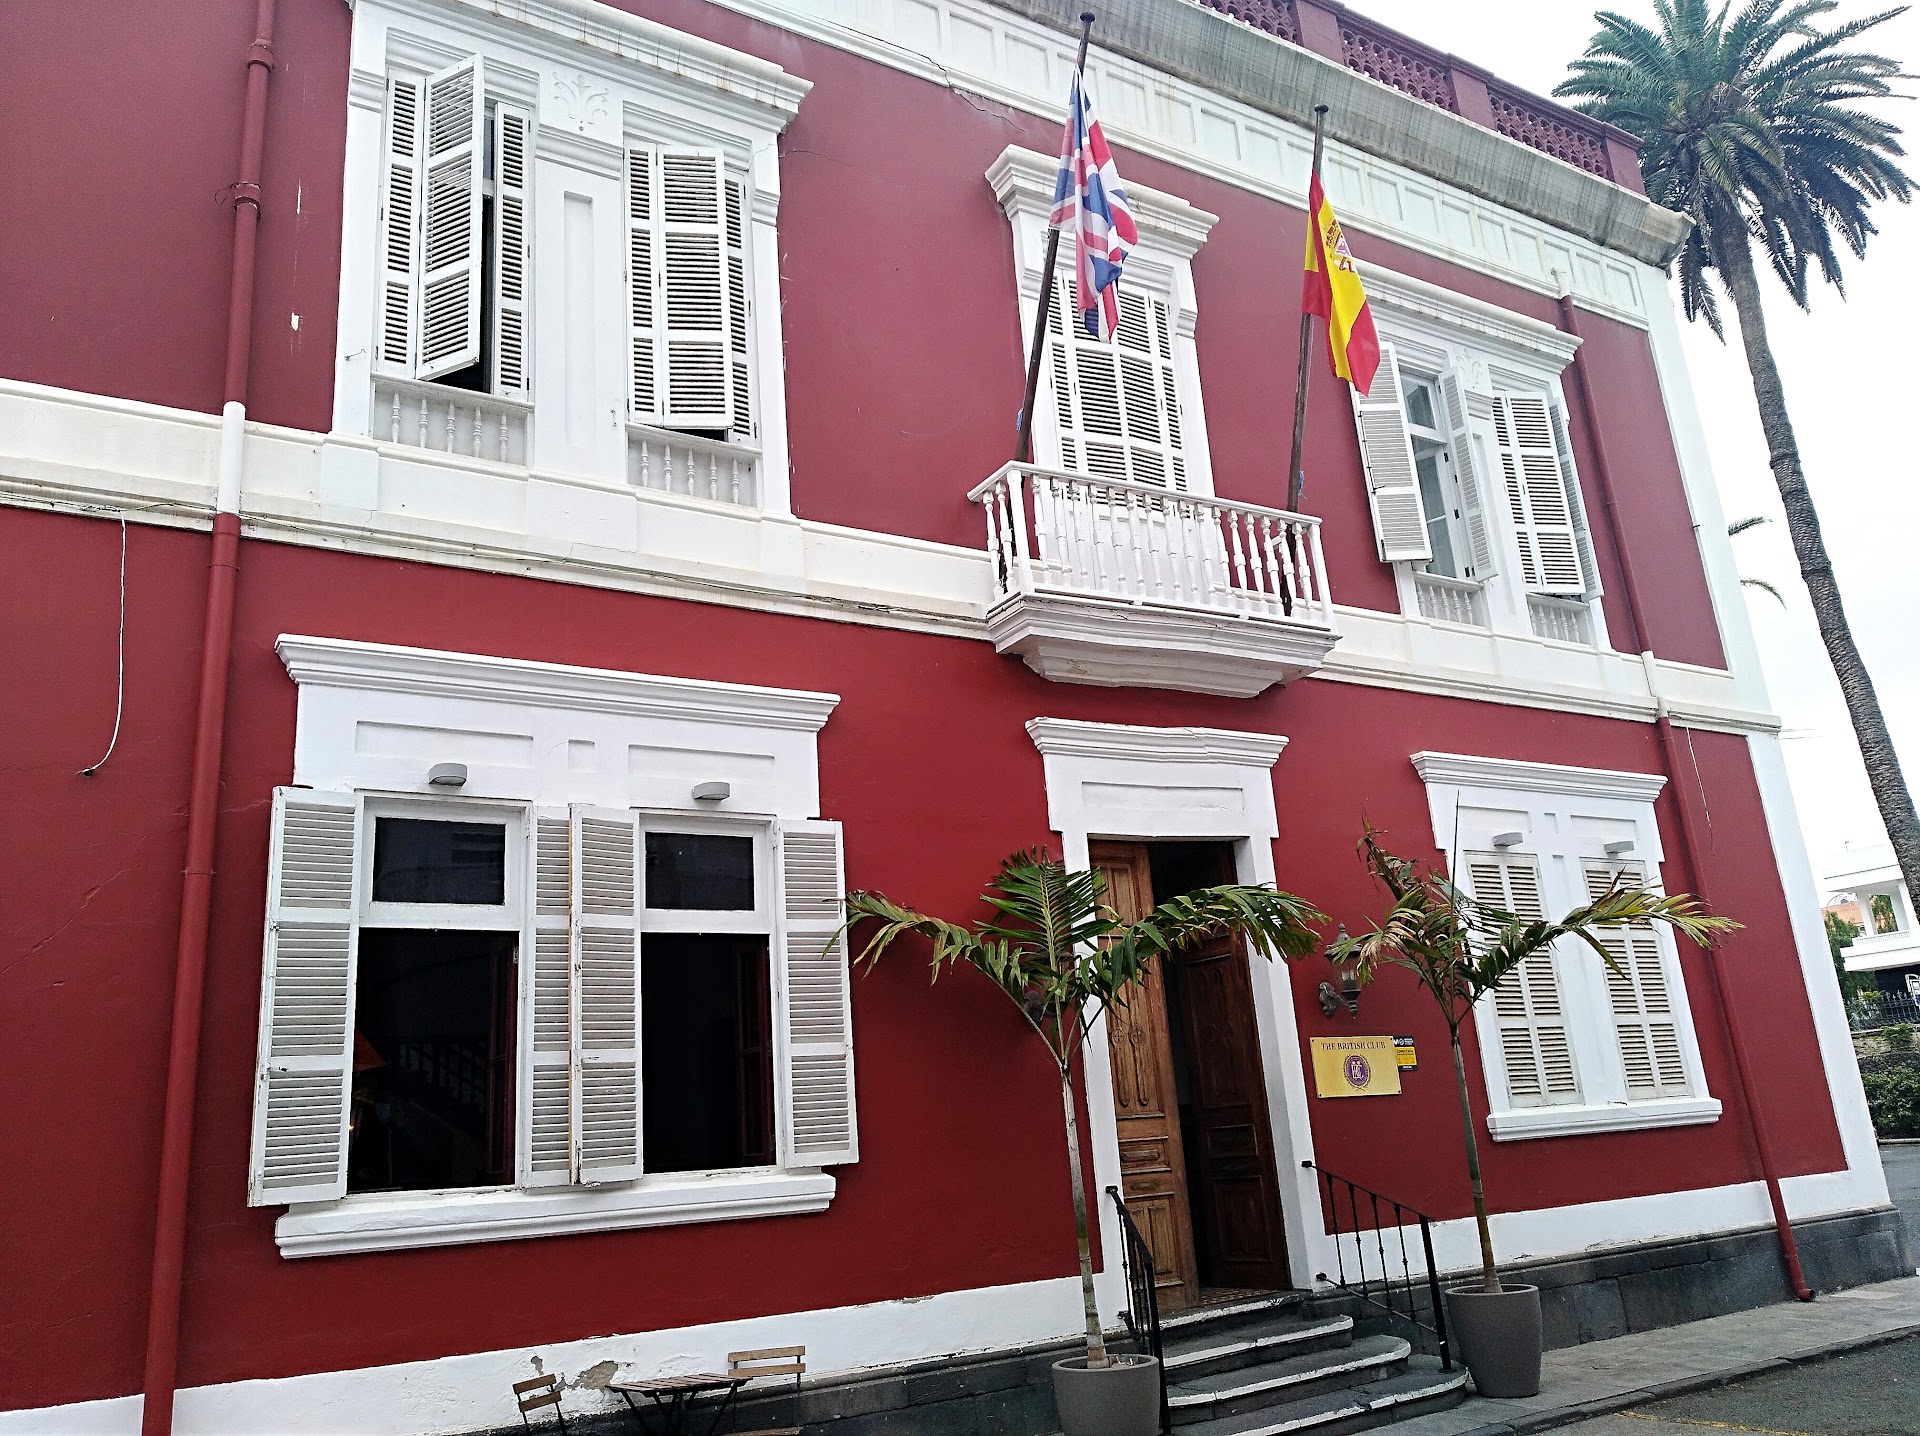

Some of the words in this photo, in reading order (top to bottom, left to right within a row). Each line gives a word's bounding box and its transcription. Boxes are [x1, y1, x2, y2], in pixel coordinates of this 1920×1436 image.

[1321, 1042, 1336, 1050] THE
[1337, 1042, 1366, 1050] BRITISH
[1367, 1041, 1386, 1049] CLUB
